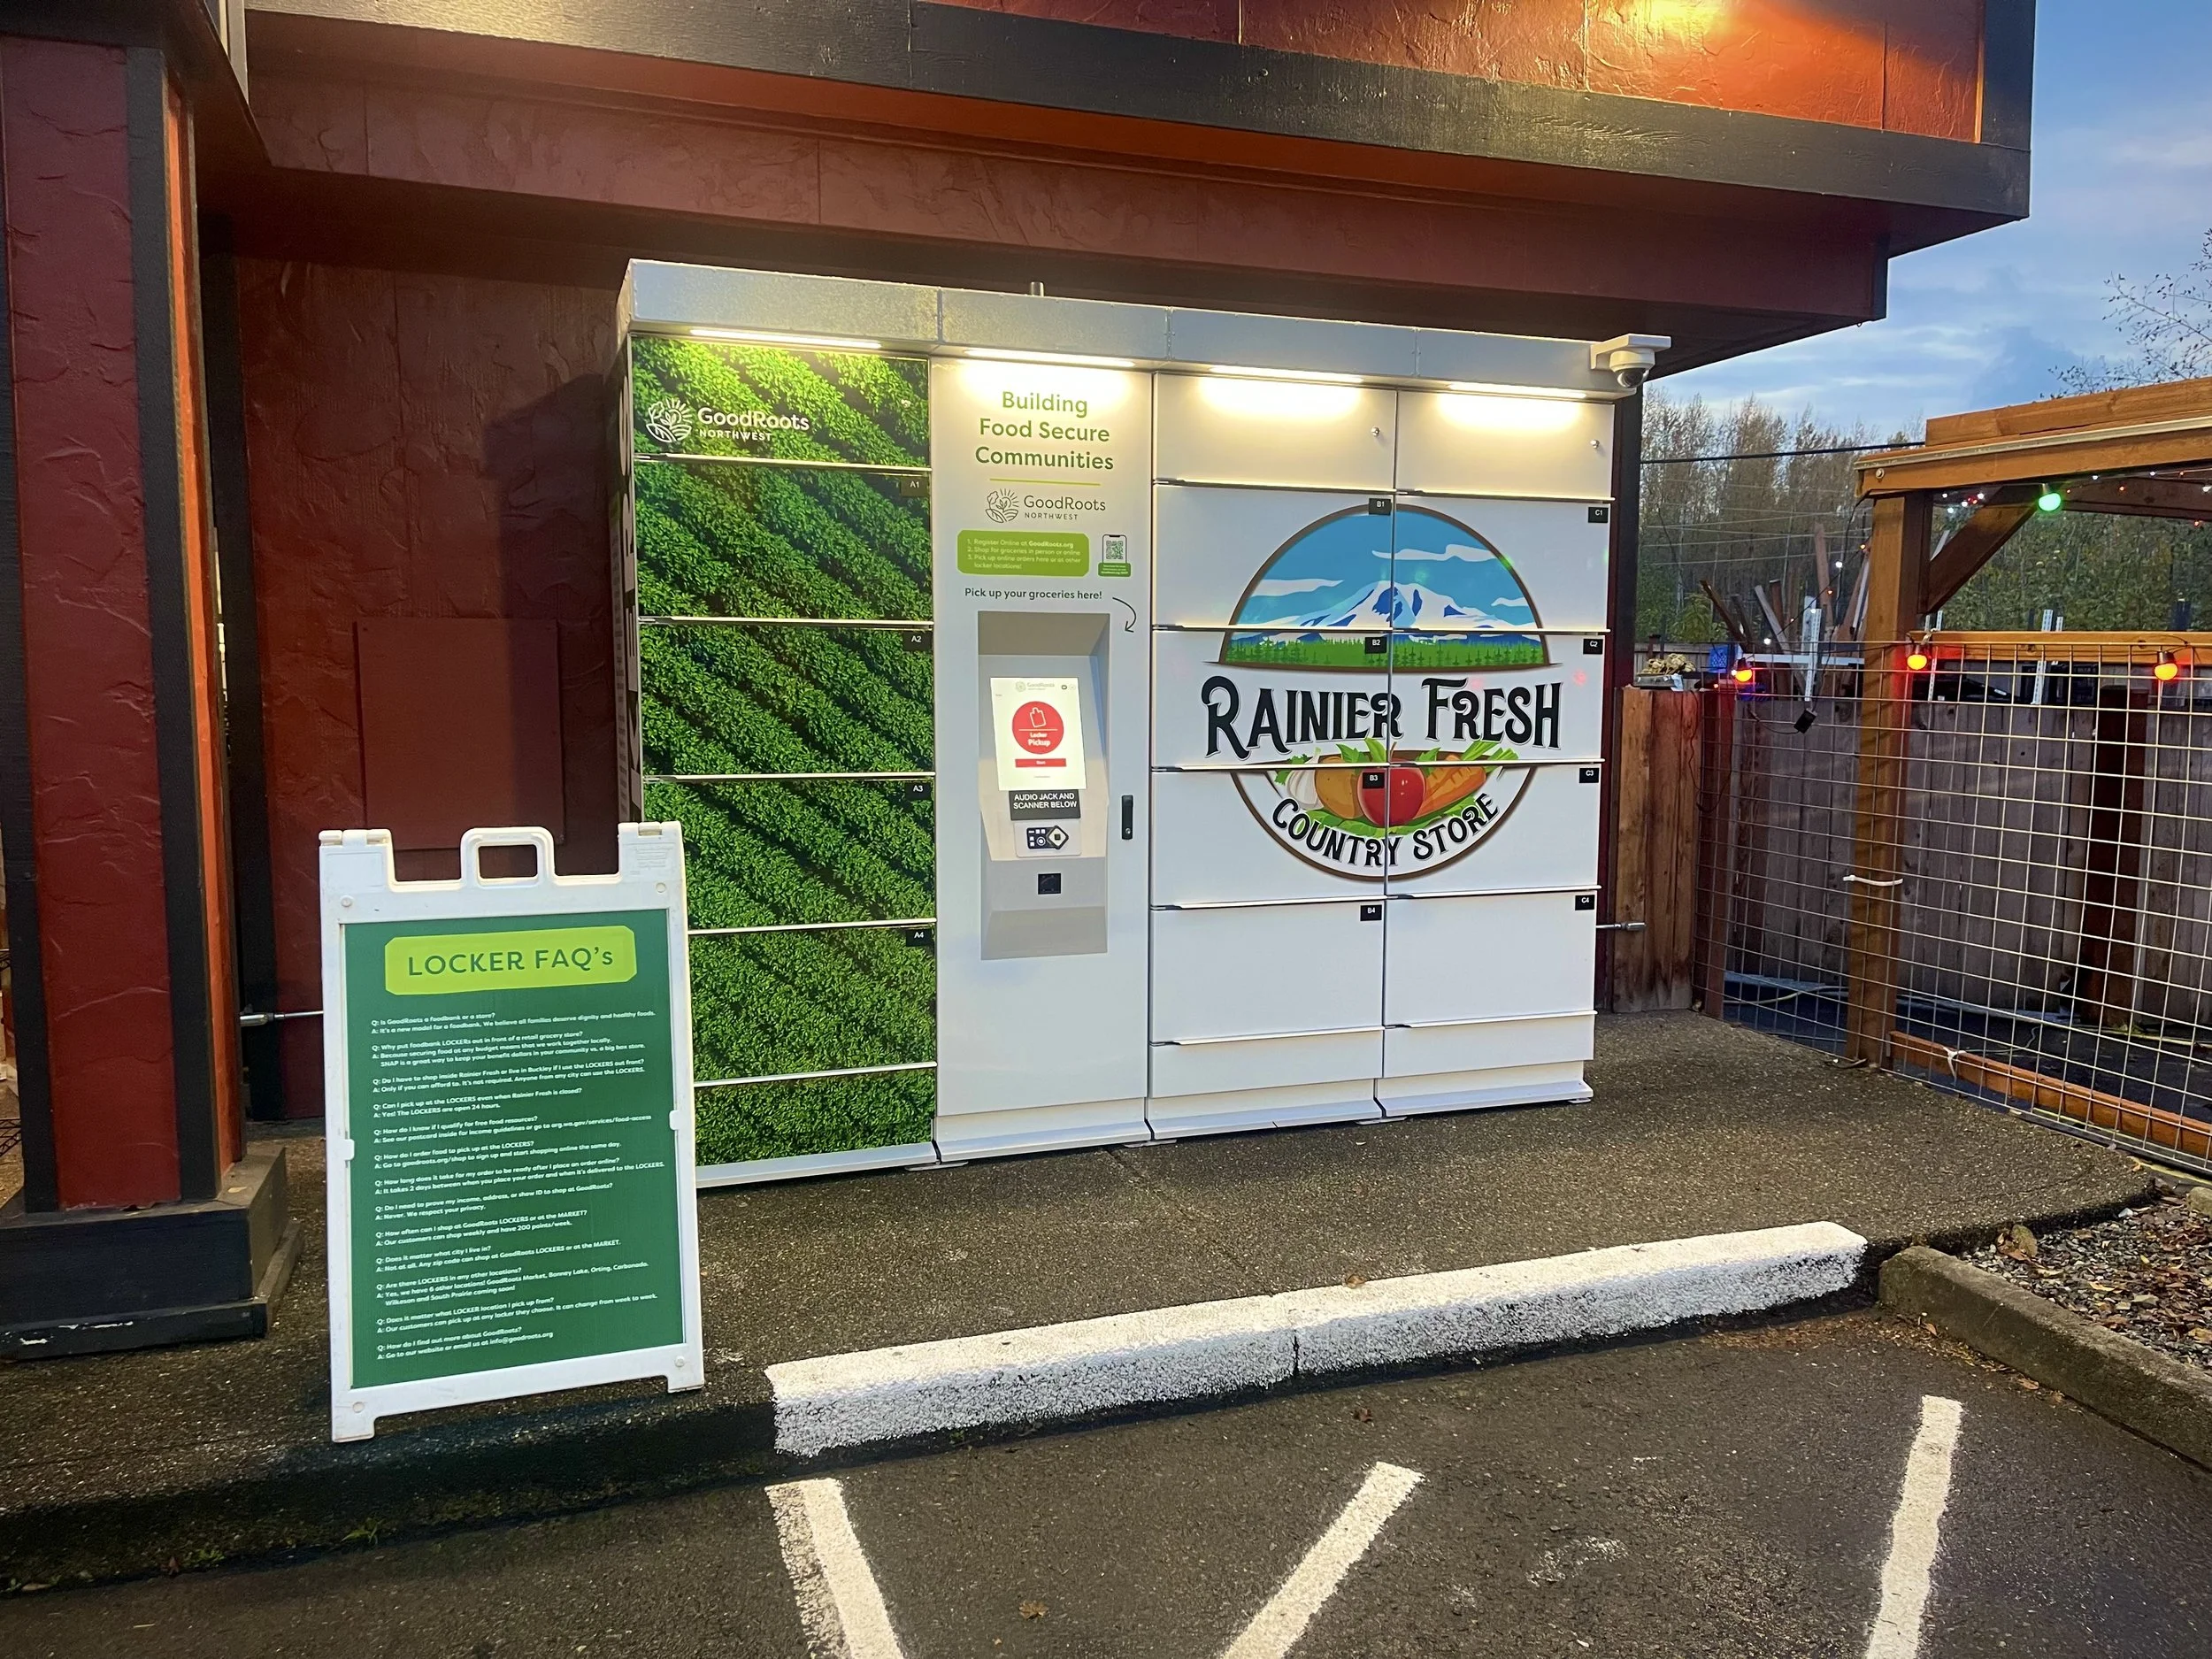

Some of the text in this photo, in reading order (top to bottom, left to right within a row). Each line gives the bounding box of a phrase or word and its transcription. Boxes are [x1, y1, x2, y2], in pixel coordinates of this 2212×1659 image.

[1002, 391, 1088, 418] Building
[697, 407, 810, 431] GoodRoots
[699, 430, 772, 442] NORTHWEST
[979, 418, 1110, 442] Food Secure
[975, 446, 1114, 470] Communities
[1024, 495, 1106, 511] GoodRoots
[964, 588, 987, 597] Pick
[988, 590, 1002, 599] up
[1003, 591, 1028, 600] your
[1029, 589, 1075, 600] groceries
[1201, 674, 1564, 760] RAINIER FRESH
[1013, 801, 1050, 810] SCANNER
[1272, 793, 1499, 867] COUNTRY STORE
[407, 946, 613, 977] LOCKER FAQ's
[504, 1115, 538, 1124] resources?
[499, 1216, 529, 1225] LOCKERS
[418, 1275, 449, 1285] LOCKERS
[488, 1267, 521, 1276] locations?
